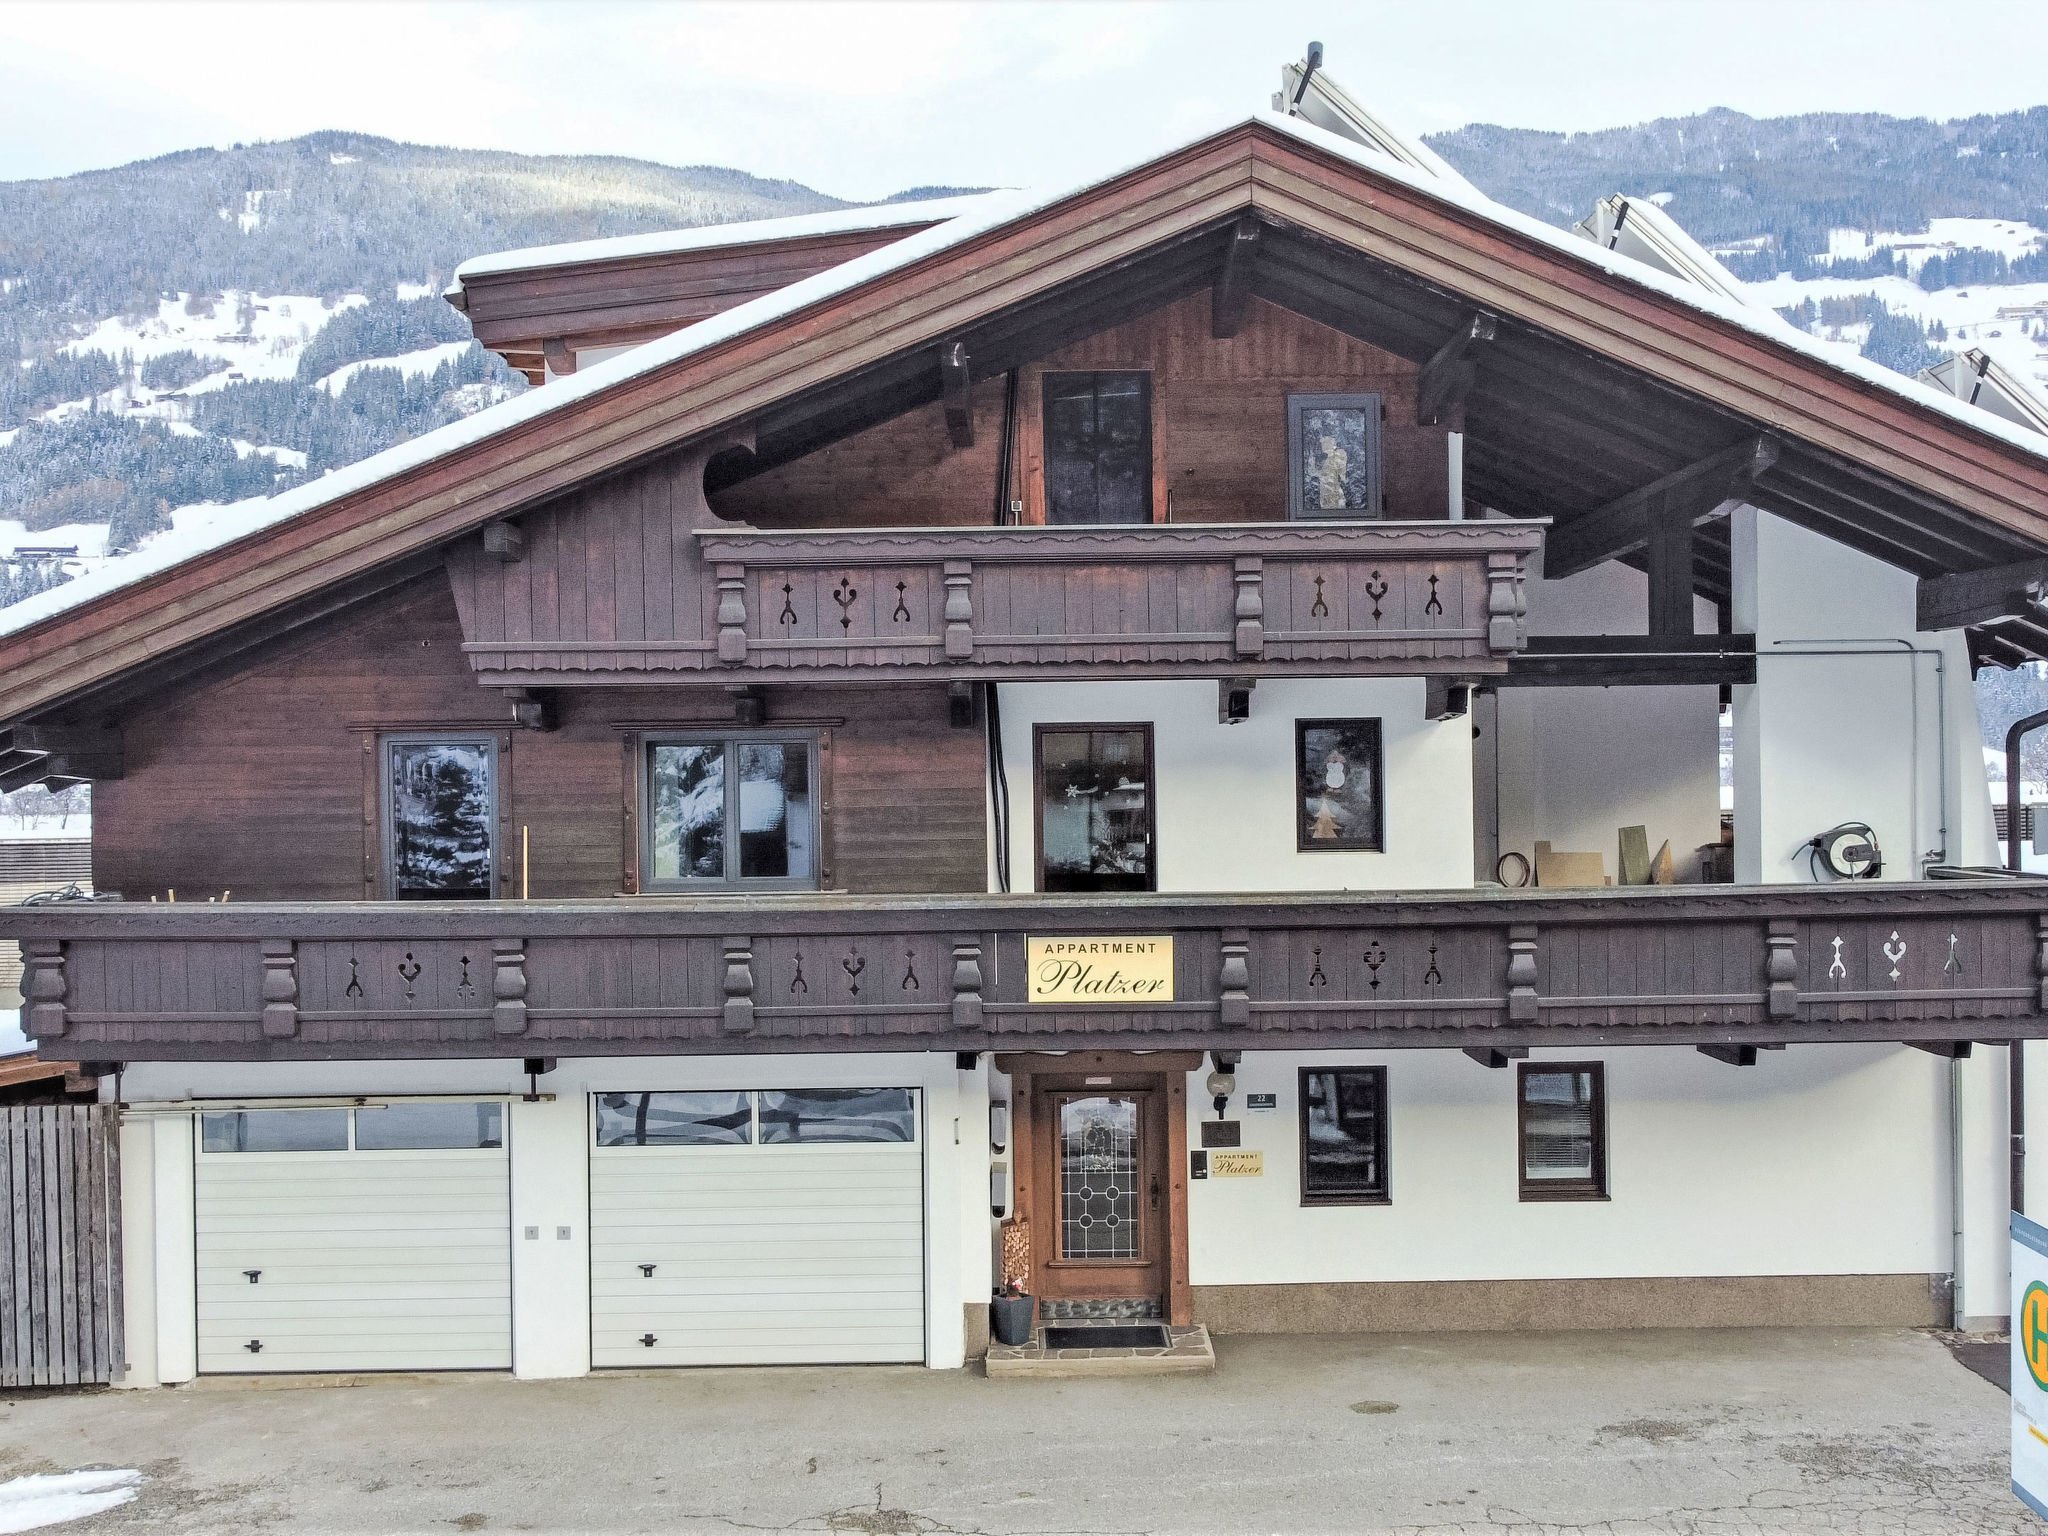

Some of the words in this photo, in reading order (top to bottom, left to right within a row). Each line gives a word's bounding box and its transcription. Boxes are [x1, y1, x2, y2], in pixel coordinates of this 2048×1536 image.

[1044, 943, 1156, 954] APPARTMENT
[1036, 958, 1165, 995] Platzer
[1212, 1159, 1262, 1174] Platzer
